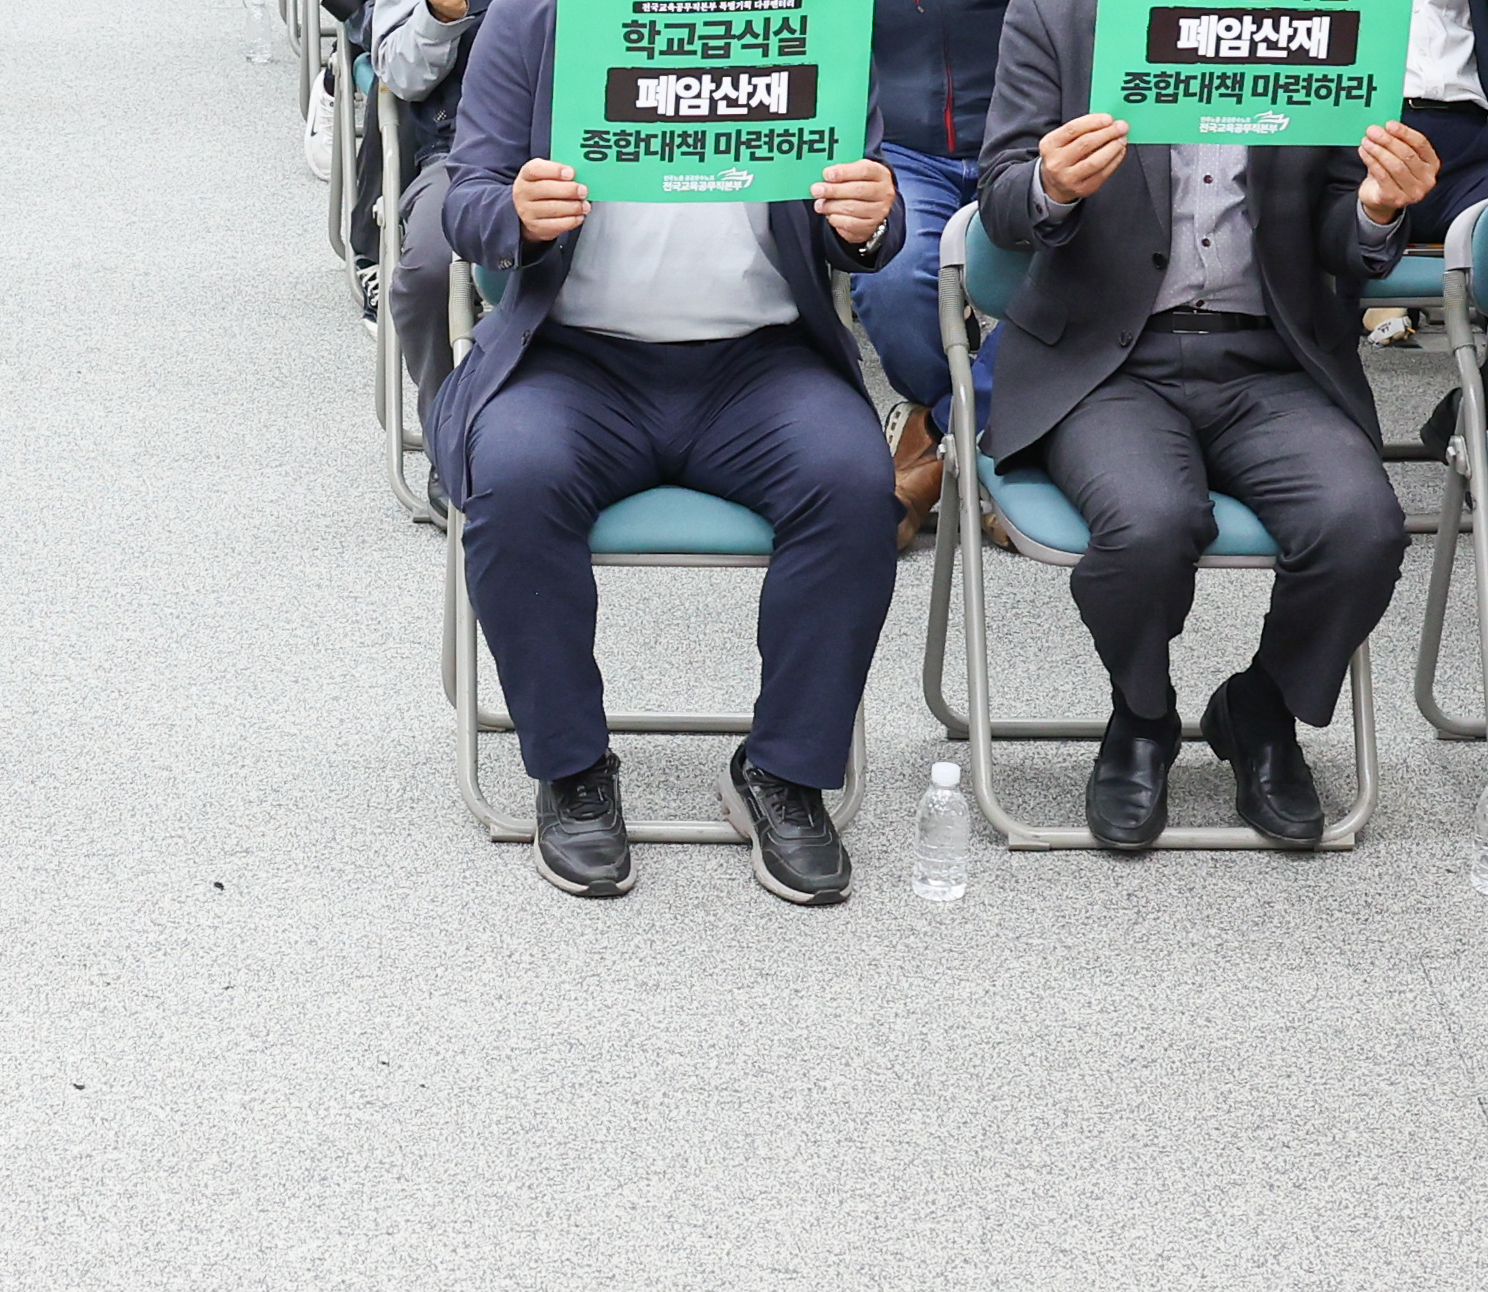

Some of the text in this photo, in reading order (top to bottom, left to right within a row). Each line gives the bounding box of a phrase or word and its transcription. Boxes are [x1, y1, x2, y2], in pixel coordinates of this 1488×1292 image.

[718, 0, 752, 10] 특별기획
[622, 16, 809, 60] 학교급식실
[1177, 15, 1330, 58] 폐암산재
[636, 72, 789, 116] 폐암산재
[1119, 70, 1377, 107] 종합대책 마련하라
[580, 127, 839, 163] 종합대책 마련하라
